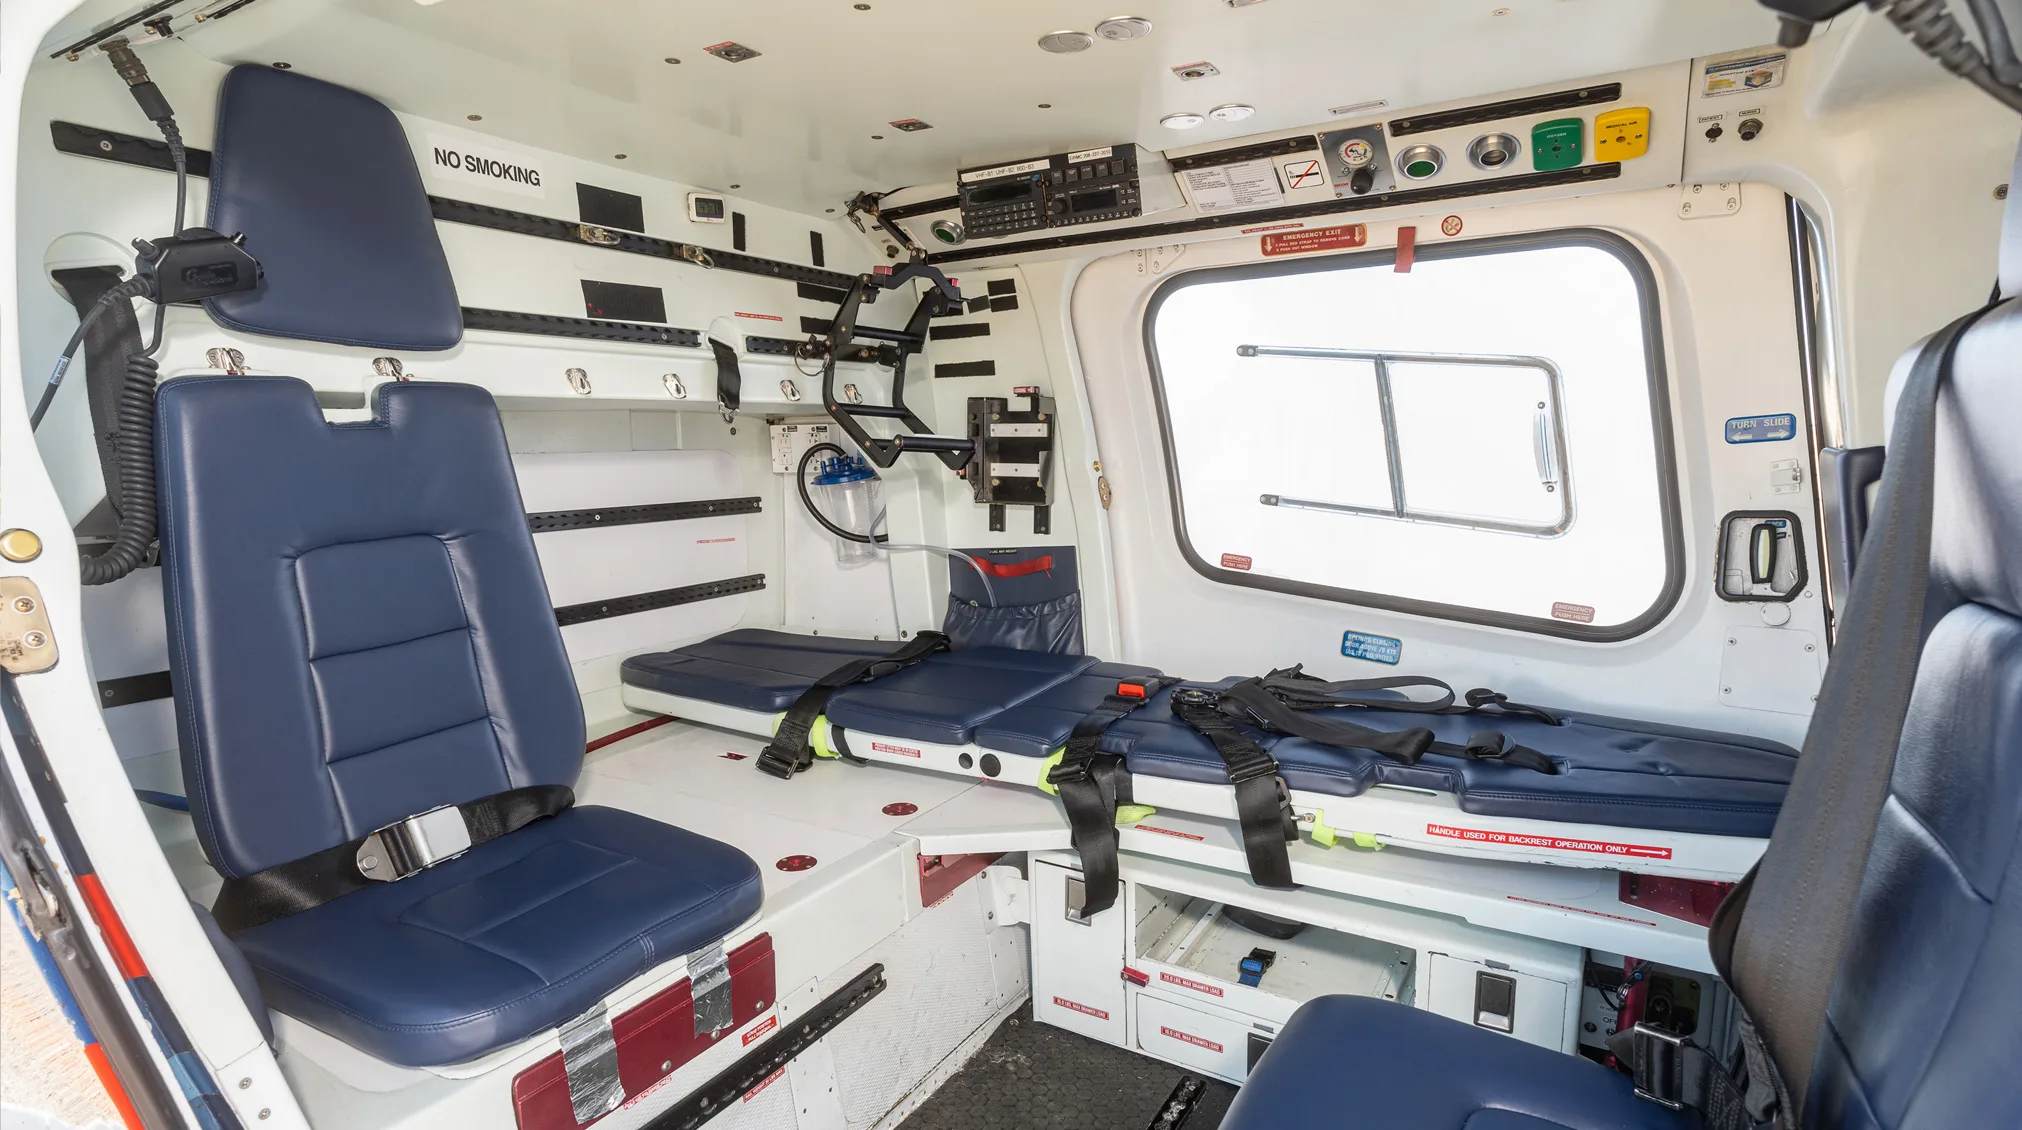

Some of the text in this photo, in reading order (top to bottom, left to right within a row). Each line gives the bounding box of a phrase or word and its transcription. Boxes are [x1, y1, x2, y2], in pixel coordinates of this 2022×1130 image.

[434, 147, 540, 186] NO SMOKING
[1283, 231, 1323, 241] EMERGENCY
[1732, 417, 1791, 429] TURN SLIDE
[1224, 554, 1250, 562] EMERGENCY
[1555, 604, 1593, 613] EMERGENCY
[1429, 826, 1461, 837] HANDLE
[1464, 831, 1486, 840] USED
[1509, 836, 1552, 846] BACKREST
[1555, 840, 1603, 851] OPERATION
[1605, 845, 1628, 853] ONLY
[1192, 981, 1208, 991] DRAWER
[1192, 1036, 1208, 1046] DRAWER
[1209, 1042, 1219, 1050] LOAD
